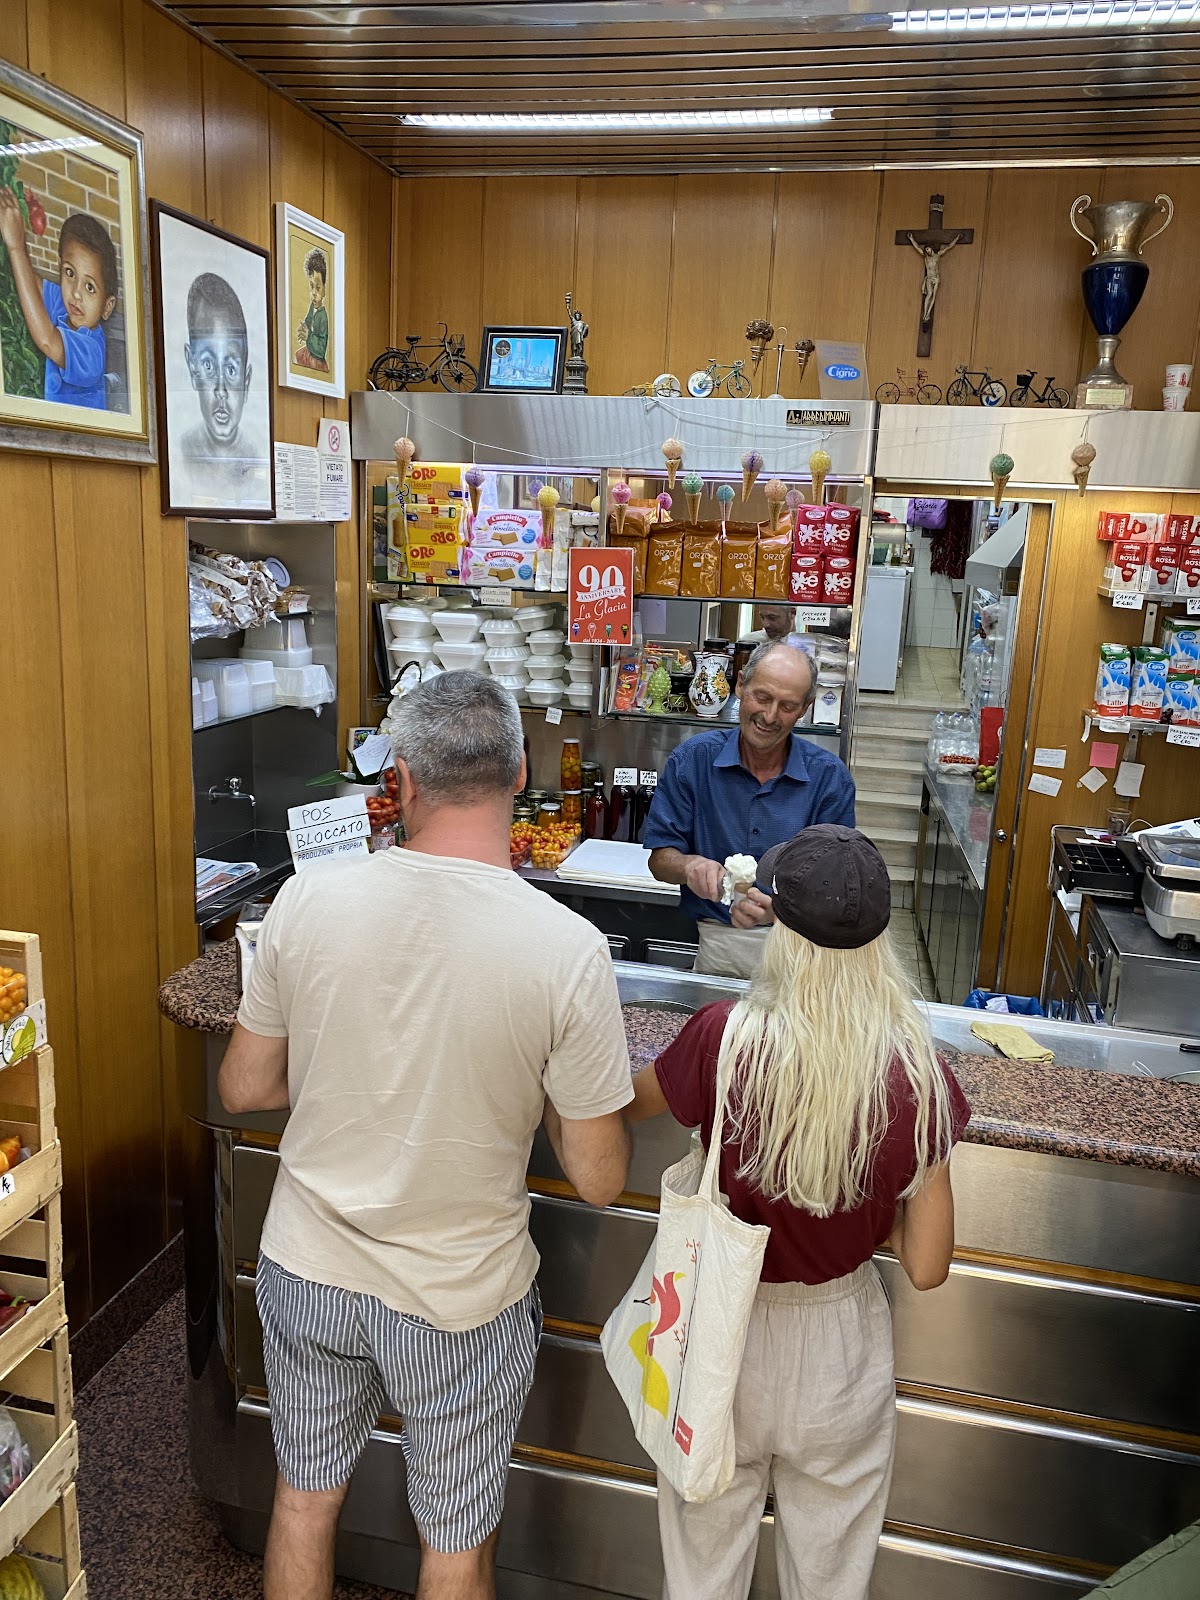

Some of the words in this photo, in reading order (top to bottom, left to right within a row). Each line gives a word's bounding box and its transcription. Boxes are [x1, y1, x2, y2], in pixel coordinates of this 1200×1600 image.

[828, 366, 857, 378] Cigno
[326, 462, 344, 472] VIETATO
[326, 474, 344, 482] FUMARE
[412, 468, 436, 480] ORO
[491, 514, 523, 523] Campiello
[1181, 520, 1190, 540] ROSSA
[430, 532, 456, 544] ORO
[410, 546, 435, 559] ORO
[488, 550, 519, 558] Campiello
[578, 565, 624, 599] 90
[580, 587, 622, 600] ANNIVERSARY
[574, 604, 591, 622] La
[594, 599, 627, 620] Glacia
[1110, 662, 1126, 670] Cigno
[1170, 682, 1187, 690] Cigno
[302, 806, 332, 824] POS
[296, 820, 363, 848] BLOCCATO
[298, 847, 334, 861] PRODUZIONE
[338, 842, 362, 852] PROPRIA
